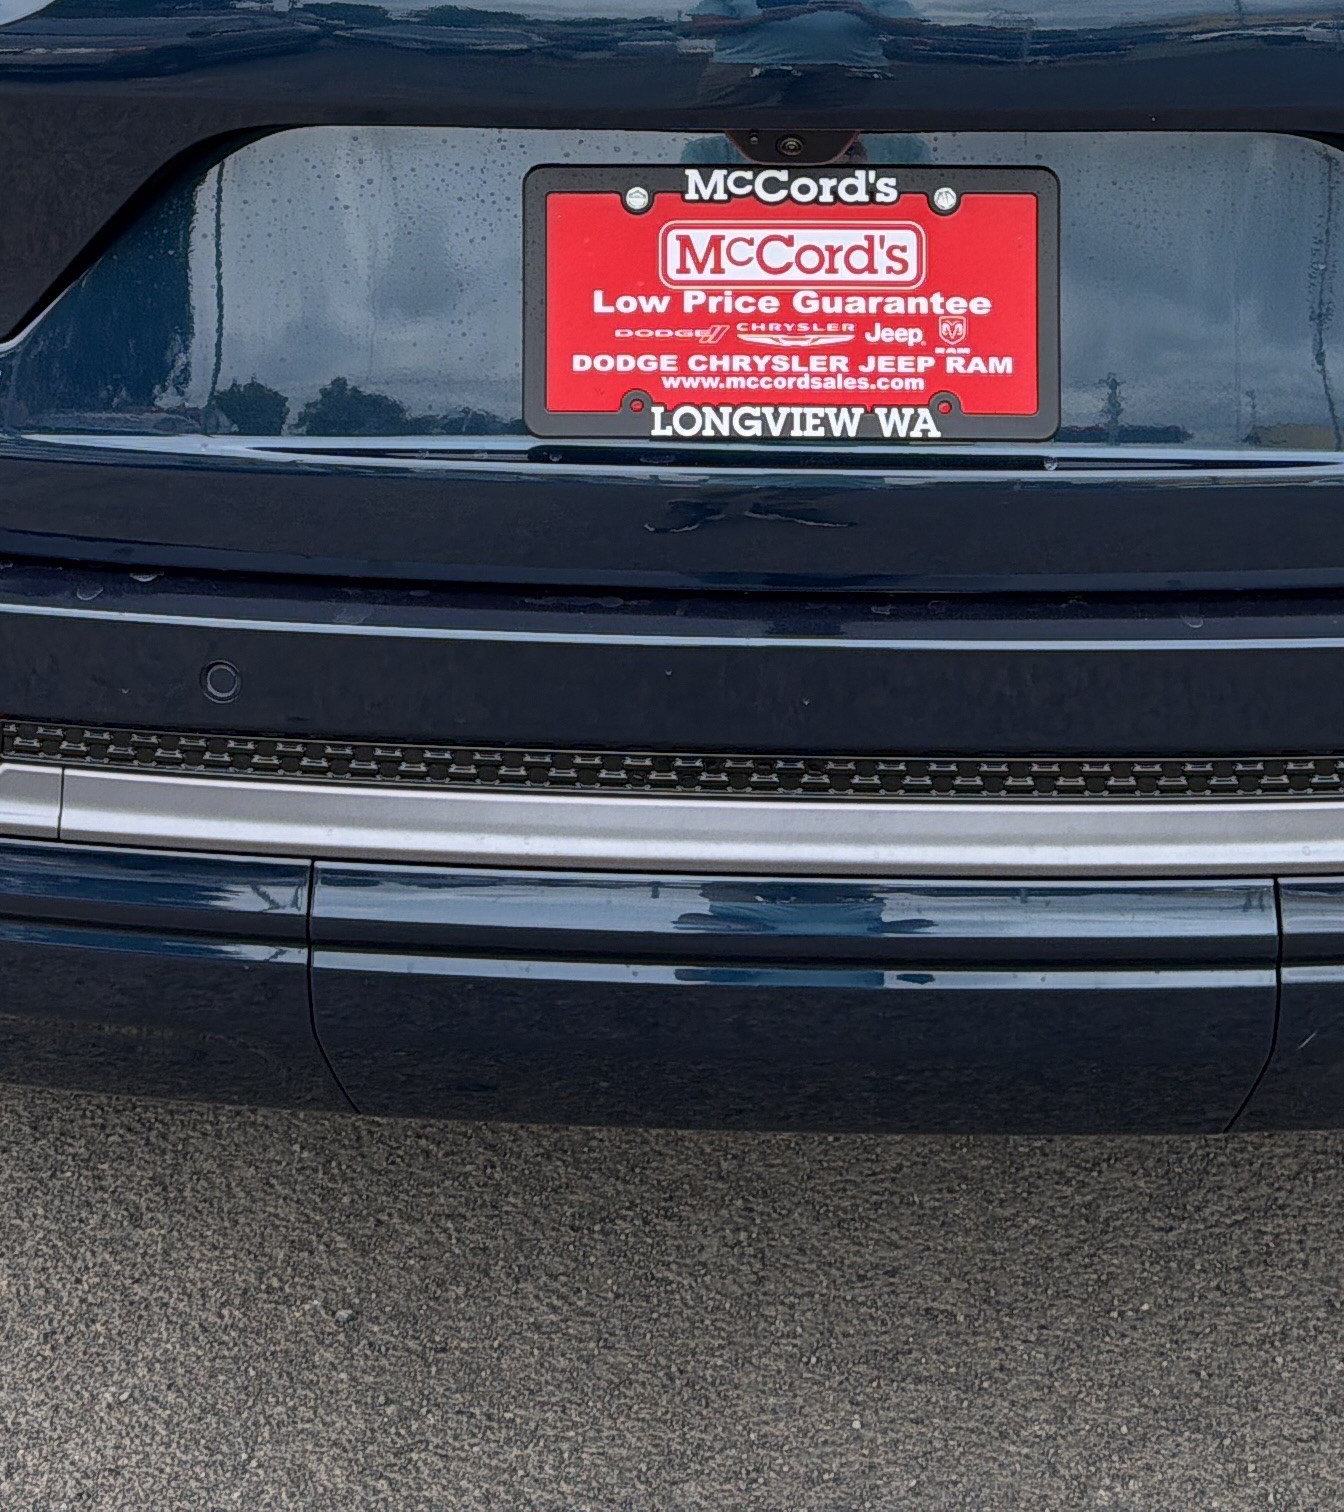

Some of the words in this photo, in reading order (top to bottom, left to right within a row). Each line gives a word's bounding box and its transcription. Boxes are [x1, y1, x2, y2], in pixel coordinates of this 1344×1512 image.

[684, 169, 898, 204] McCord's
[675, 234, 911, 276] McCord's
[593, 291, 669, 314] Low
[683, 290, 780, 314] Price
[792, 290, 992, 316] Guarantee
[614, 328, 711, 339] DODGE
[736, 322, 855, 332] CHRYSLER
[864, 322, 924, 346] Jeep
[572, 354, 678, 372] DODGE
[687, 354, 850, 373] CHRYSLER
[859, 355, 935, 373] JEEP
[945, 356, 1014, 375] RAM
[661, 373, 926, 391] www.mccordsales.com
[651, 406, 864, 437] LONGVIEW
[875, 407, 941, 438] WA
